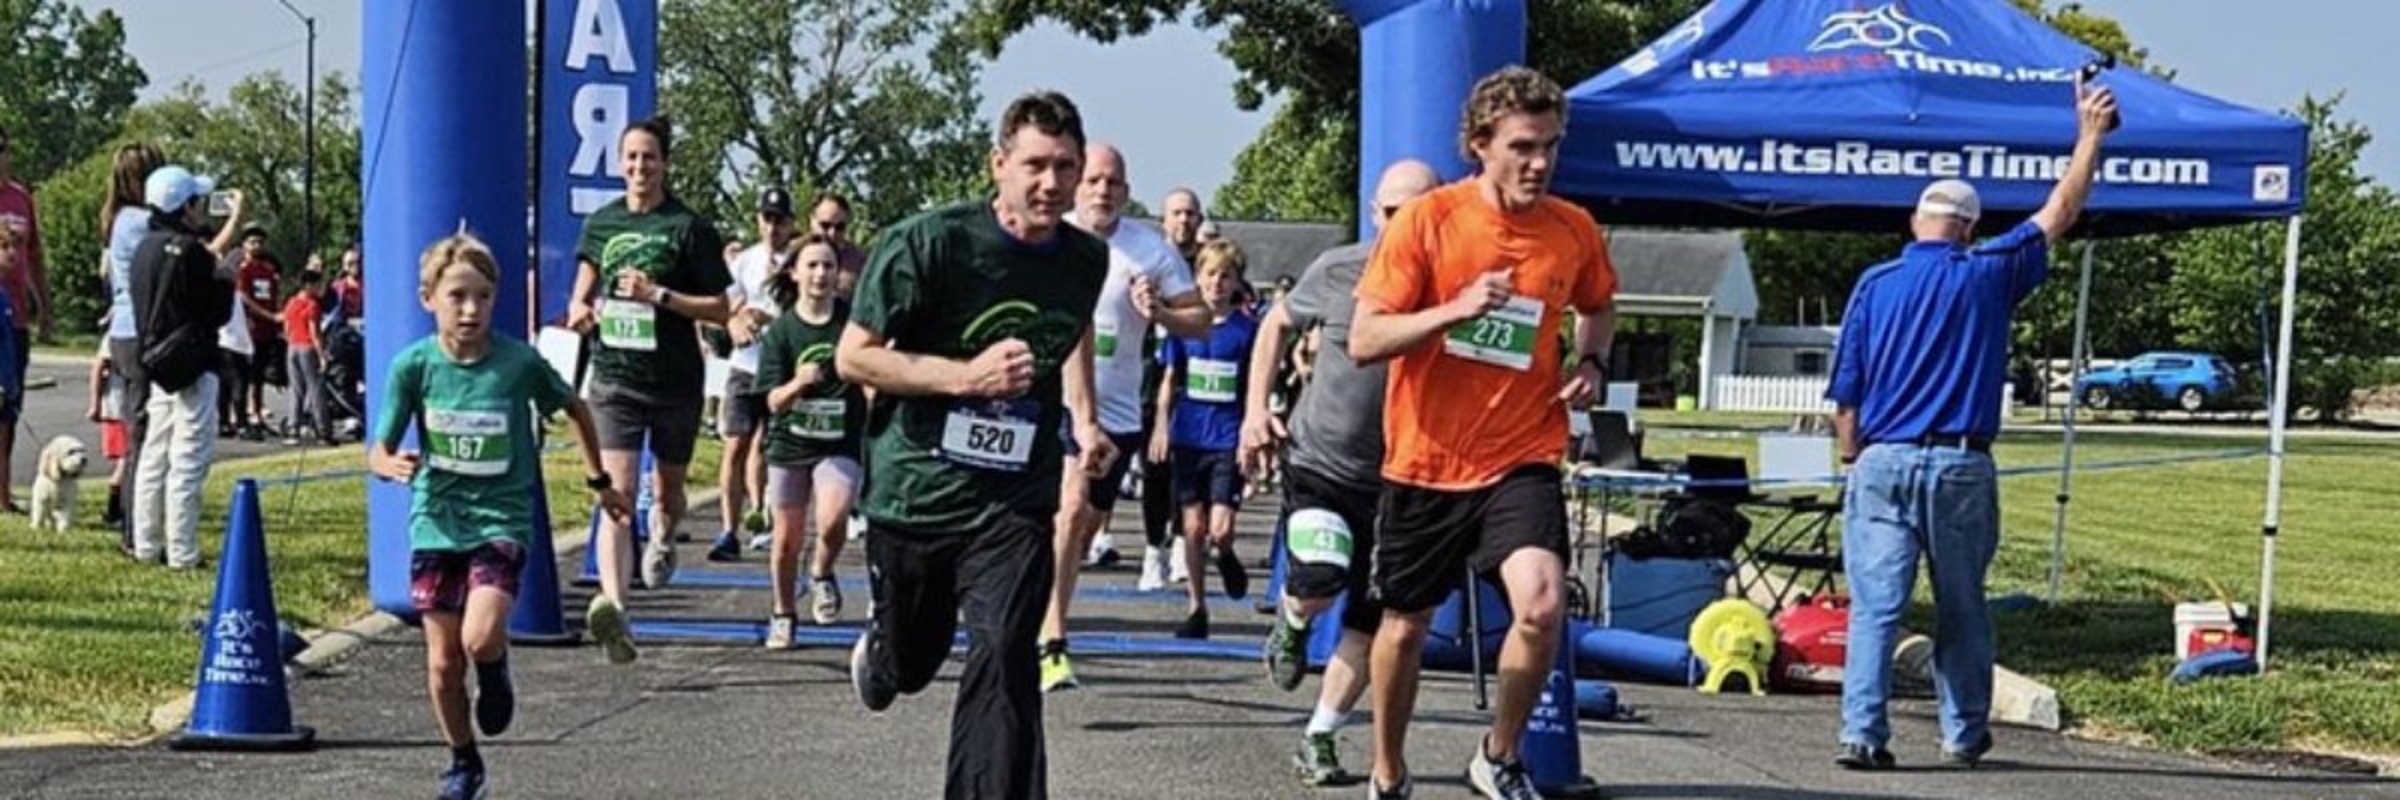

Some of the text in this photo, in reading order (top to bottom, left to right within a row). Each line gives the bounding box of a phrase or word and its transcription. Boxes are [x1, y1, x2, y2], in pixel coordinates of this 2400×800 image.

[1472, 317, 1515, 349] 273
[448, 436, 485, 459] 167
[967, 423, 1015, 456] 520
